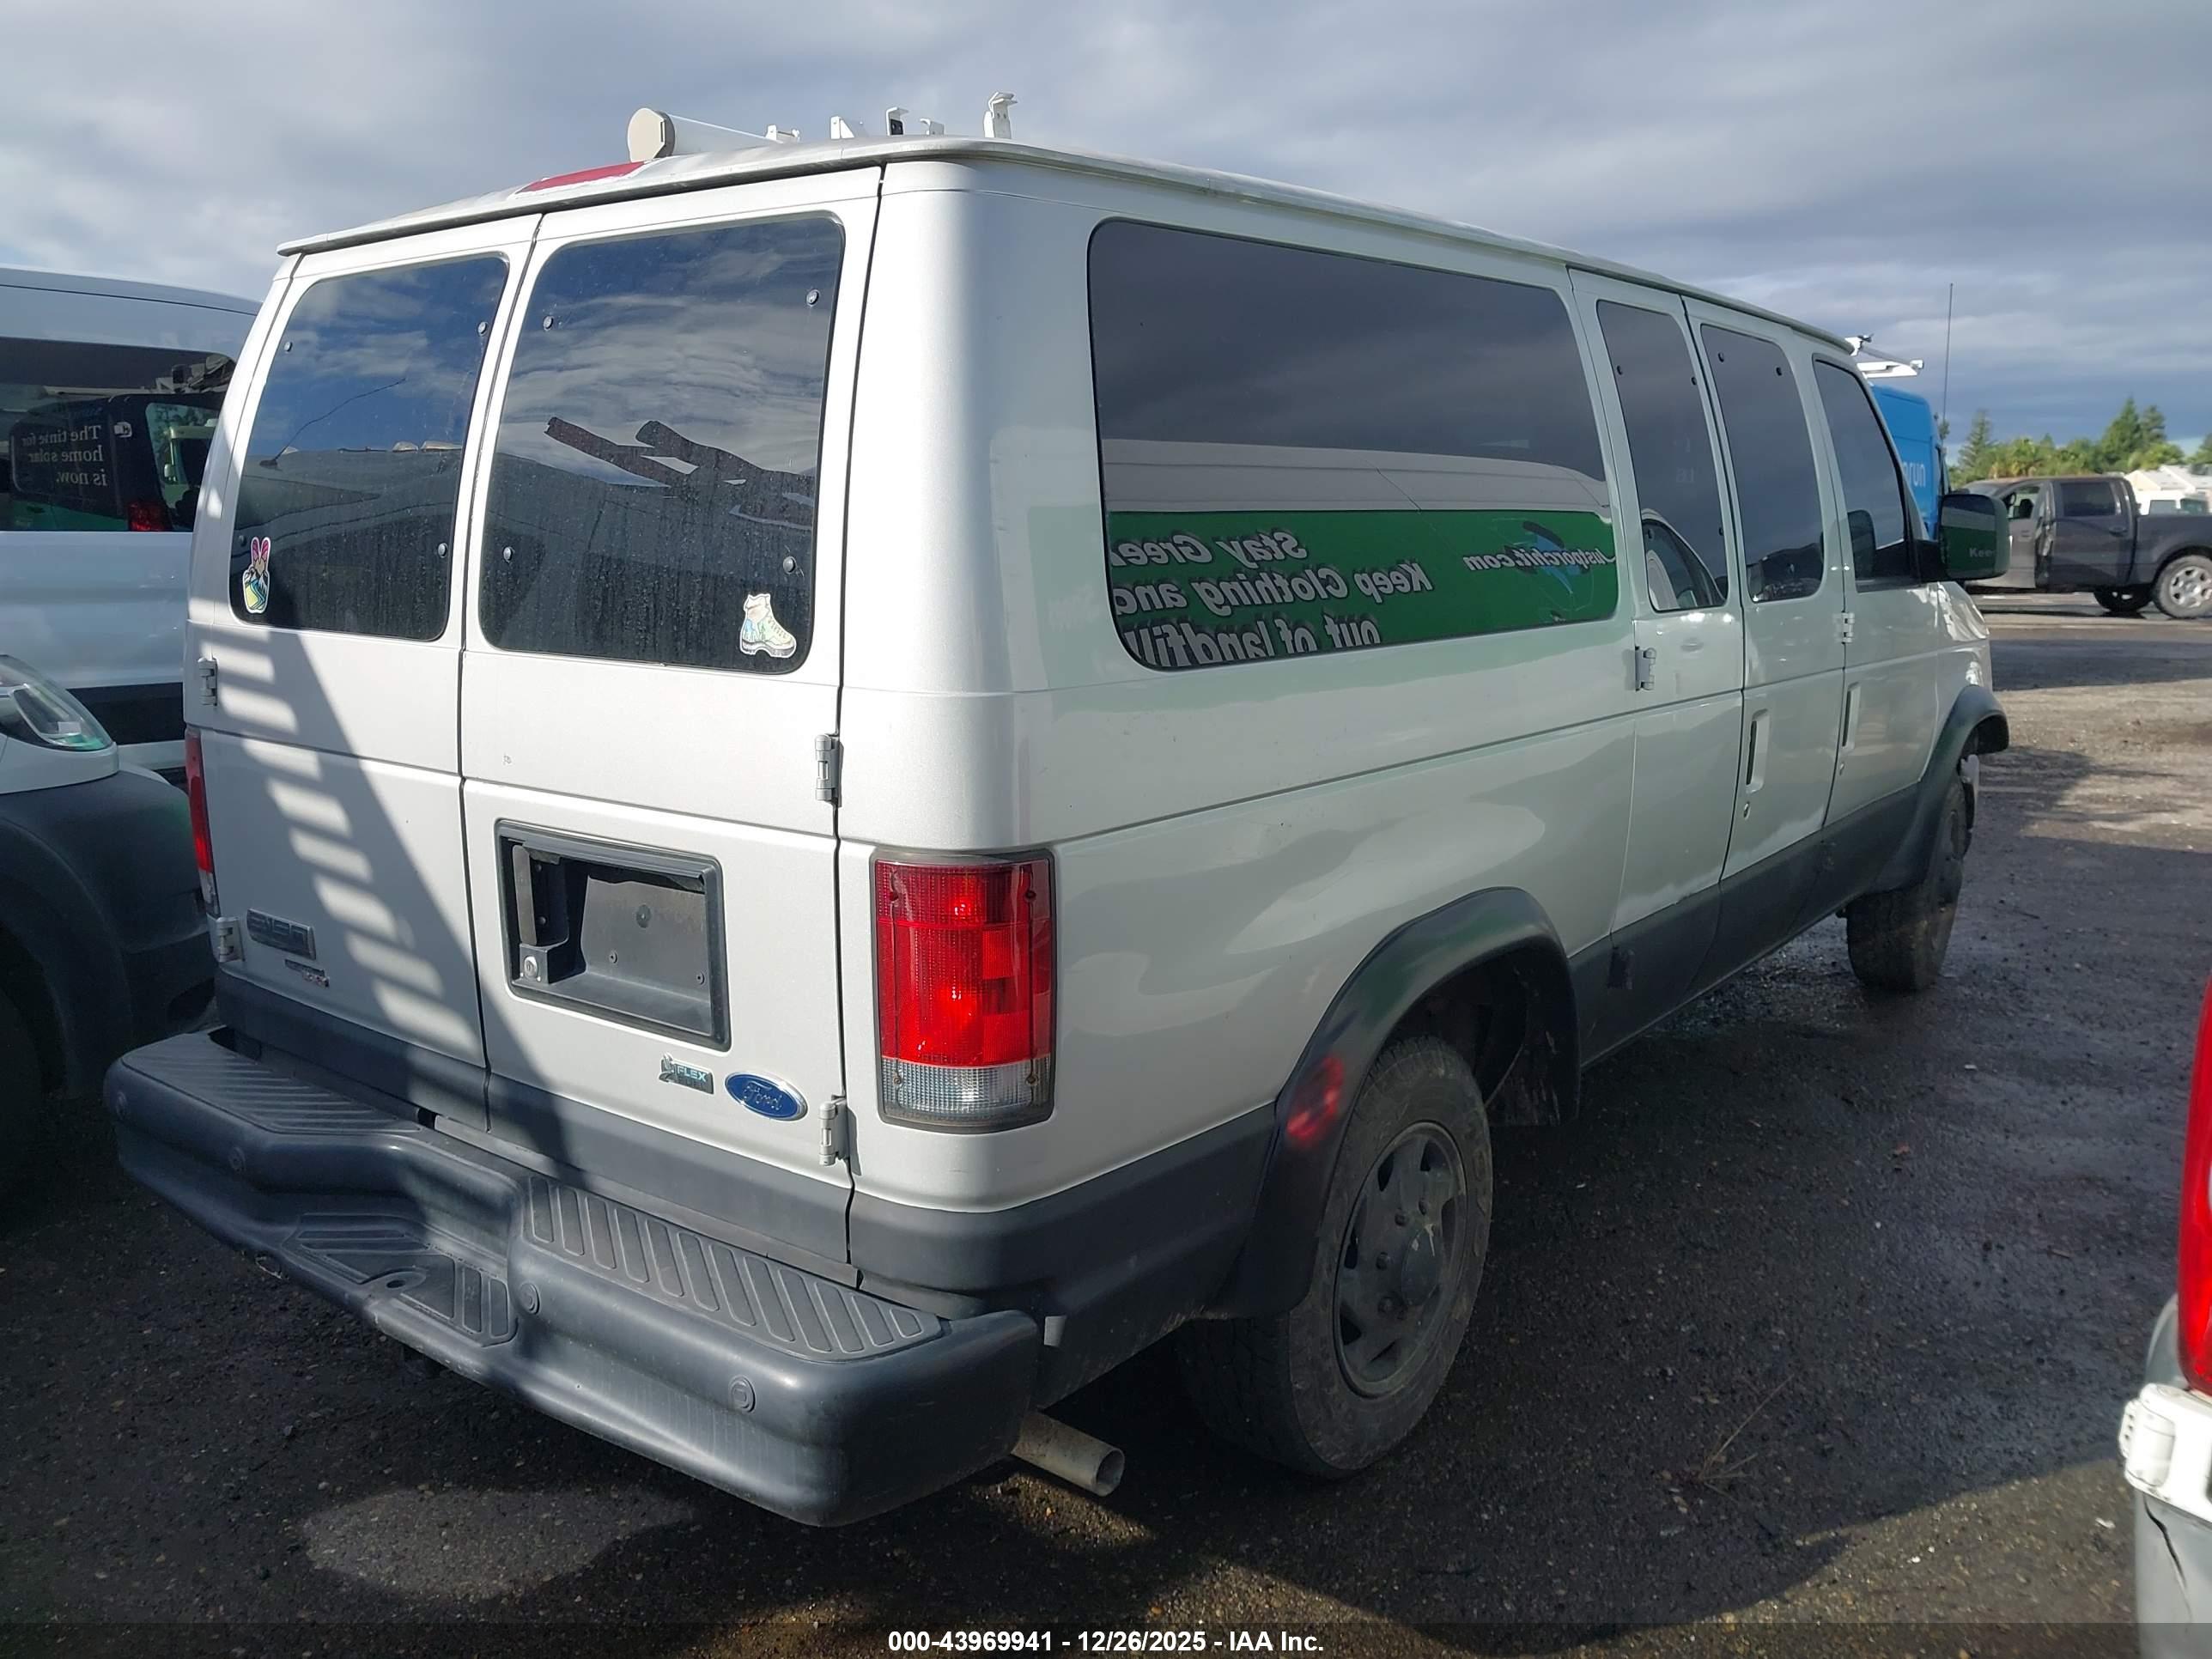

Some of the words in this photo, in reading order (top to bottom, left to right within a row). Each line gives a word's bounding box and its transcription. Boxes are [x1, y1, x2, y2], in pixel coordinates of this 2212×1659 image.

[1900, 461, 1926, 488] run
[677, 1065, 707, 1083] FLEX
[742, 1079, 784, 1112] Ford
